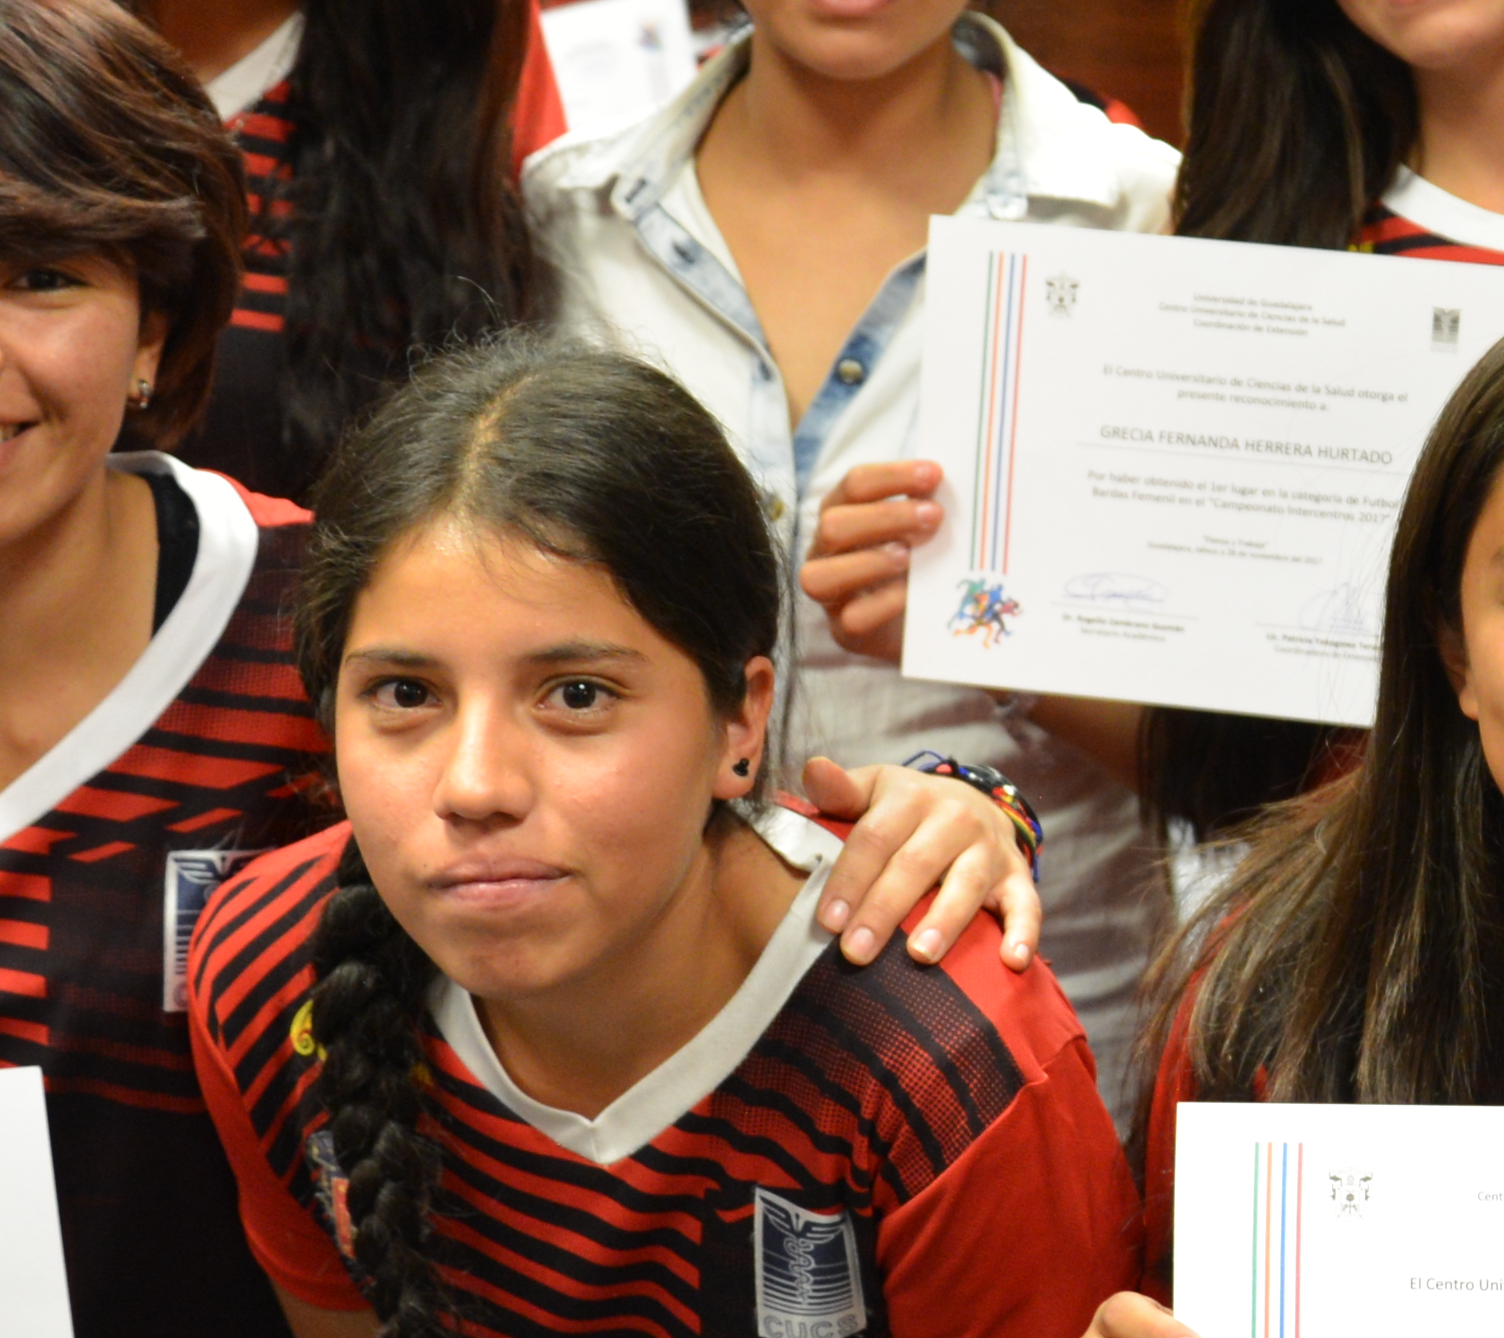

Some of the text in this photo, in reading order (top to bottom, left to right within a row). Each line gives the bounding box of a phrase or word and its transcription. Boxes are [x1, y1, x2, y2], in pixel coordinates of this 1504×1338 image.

[1099, 425, 1393, 465] GRECIA FERNANDA HERRERA HURTADO
[1409, 1276, 1421, 1290] El
[1425, 1277, 1475, 1291] Centro
